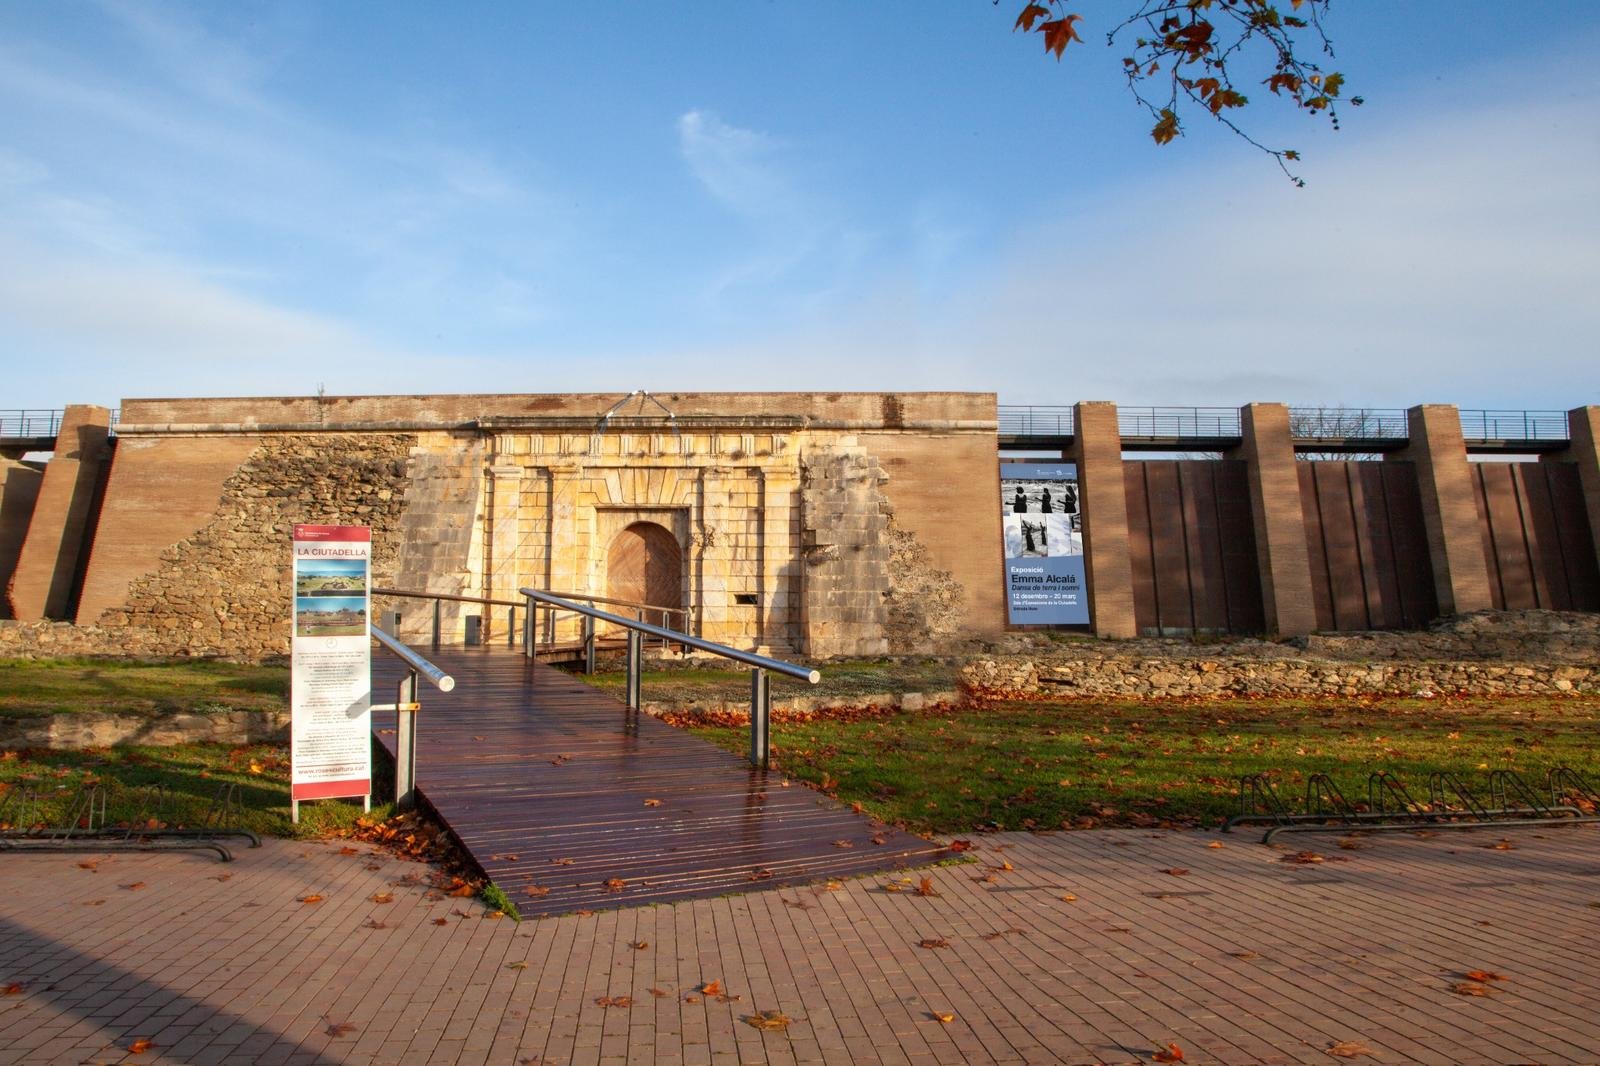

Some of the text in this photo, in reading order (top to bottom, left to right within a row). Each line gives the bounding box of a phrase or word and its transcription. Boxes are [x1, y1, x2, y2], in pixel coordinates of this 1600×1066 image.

[297, 548, 367, 556] LA CIUTADELLA
[1010, 566, 1044, 574] Exposició
[1011, 574, 1076, 584] Emma Alcalá
